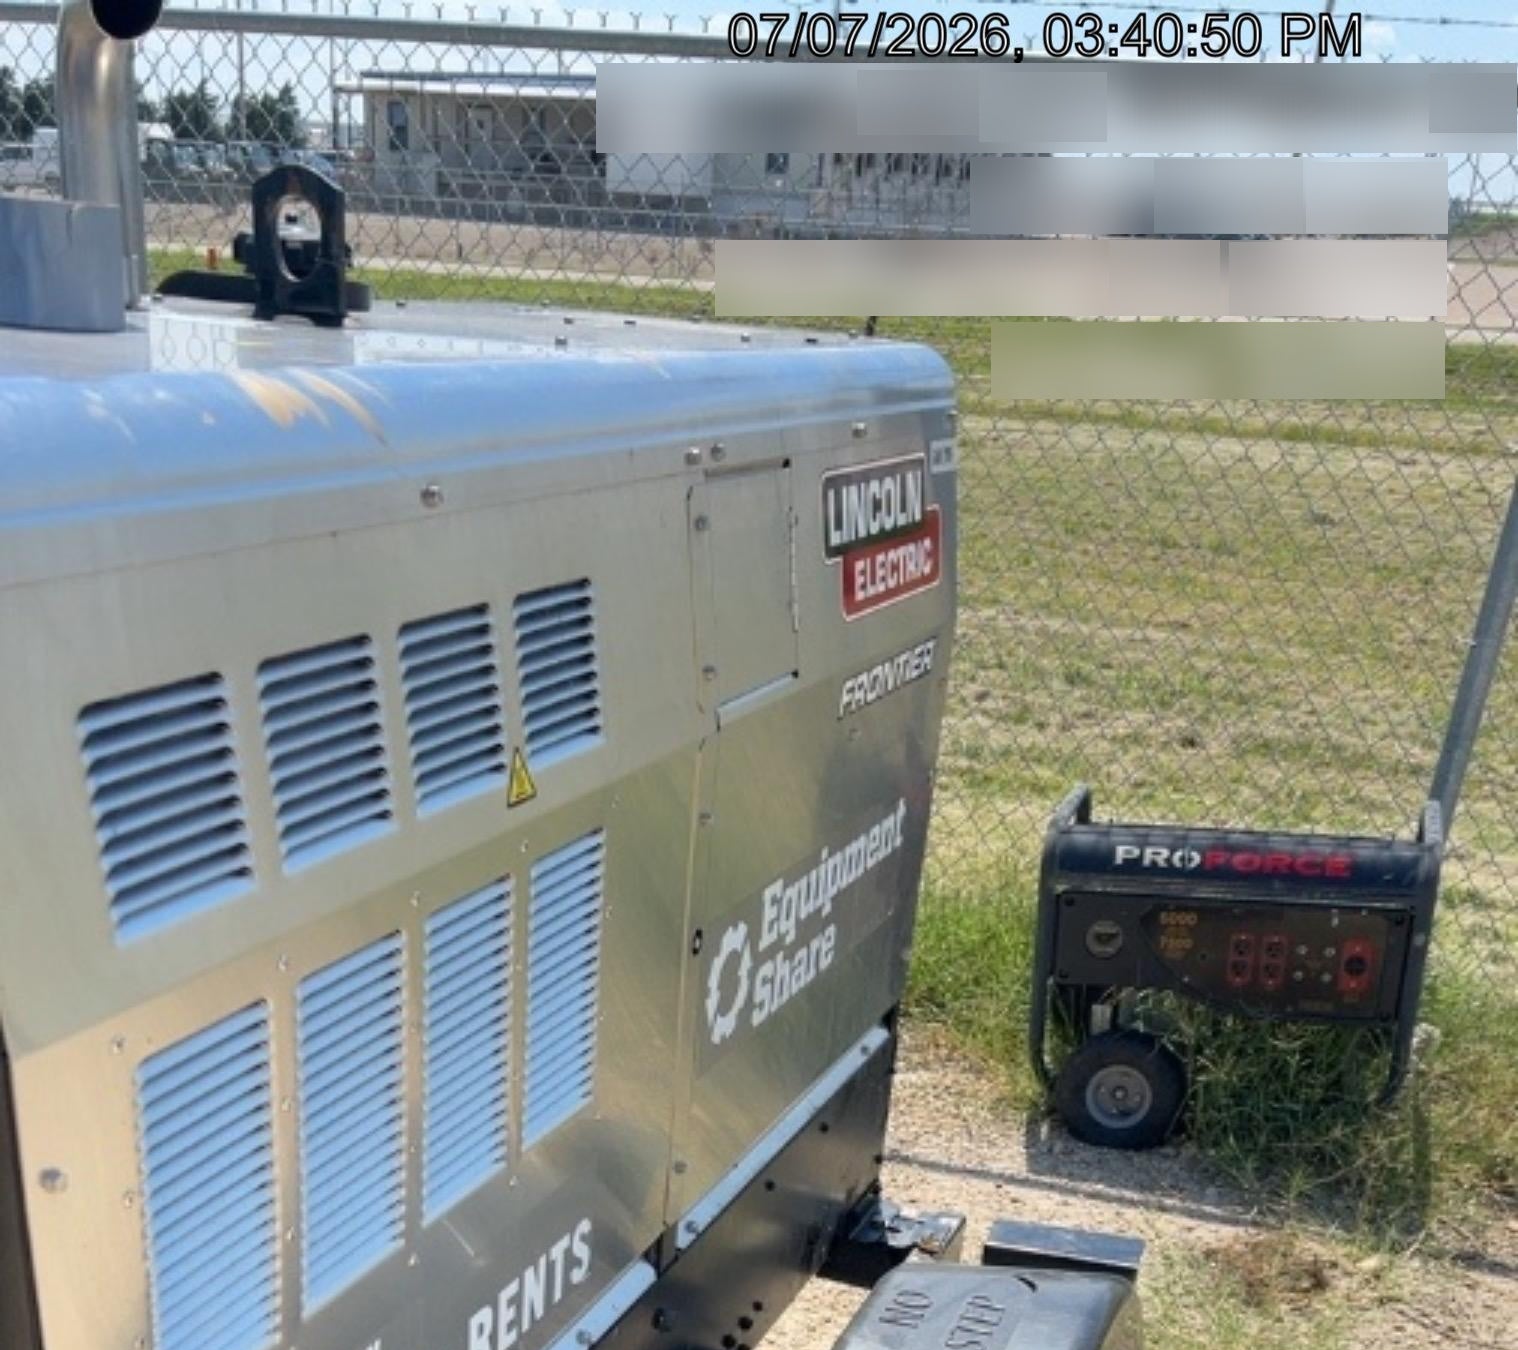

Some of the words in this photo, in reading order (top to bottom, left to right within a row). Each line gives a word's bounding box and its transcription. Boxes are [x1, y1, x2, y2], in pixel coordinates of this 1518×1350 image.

[827, 470, 922, 546] LINCOLN
[854, 536, 933, 601] ELECTRIC
[837, 637, 937, 720] FRONTIER
[758, 798, 906, 951] Equipment
[752, 923, 837, 1027] Share
[878, 1289, 934, 1329] NO
